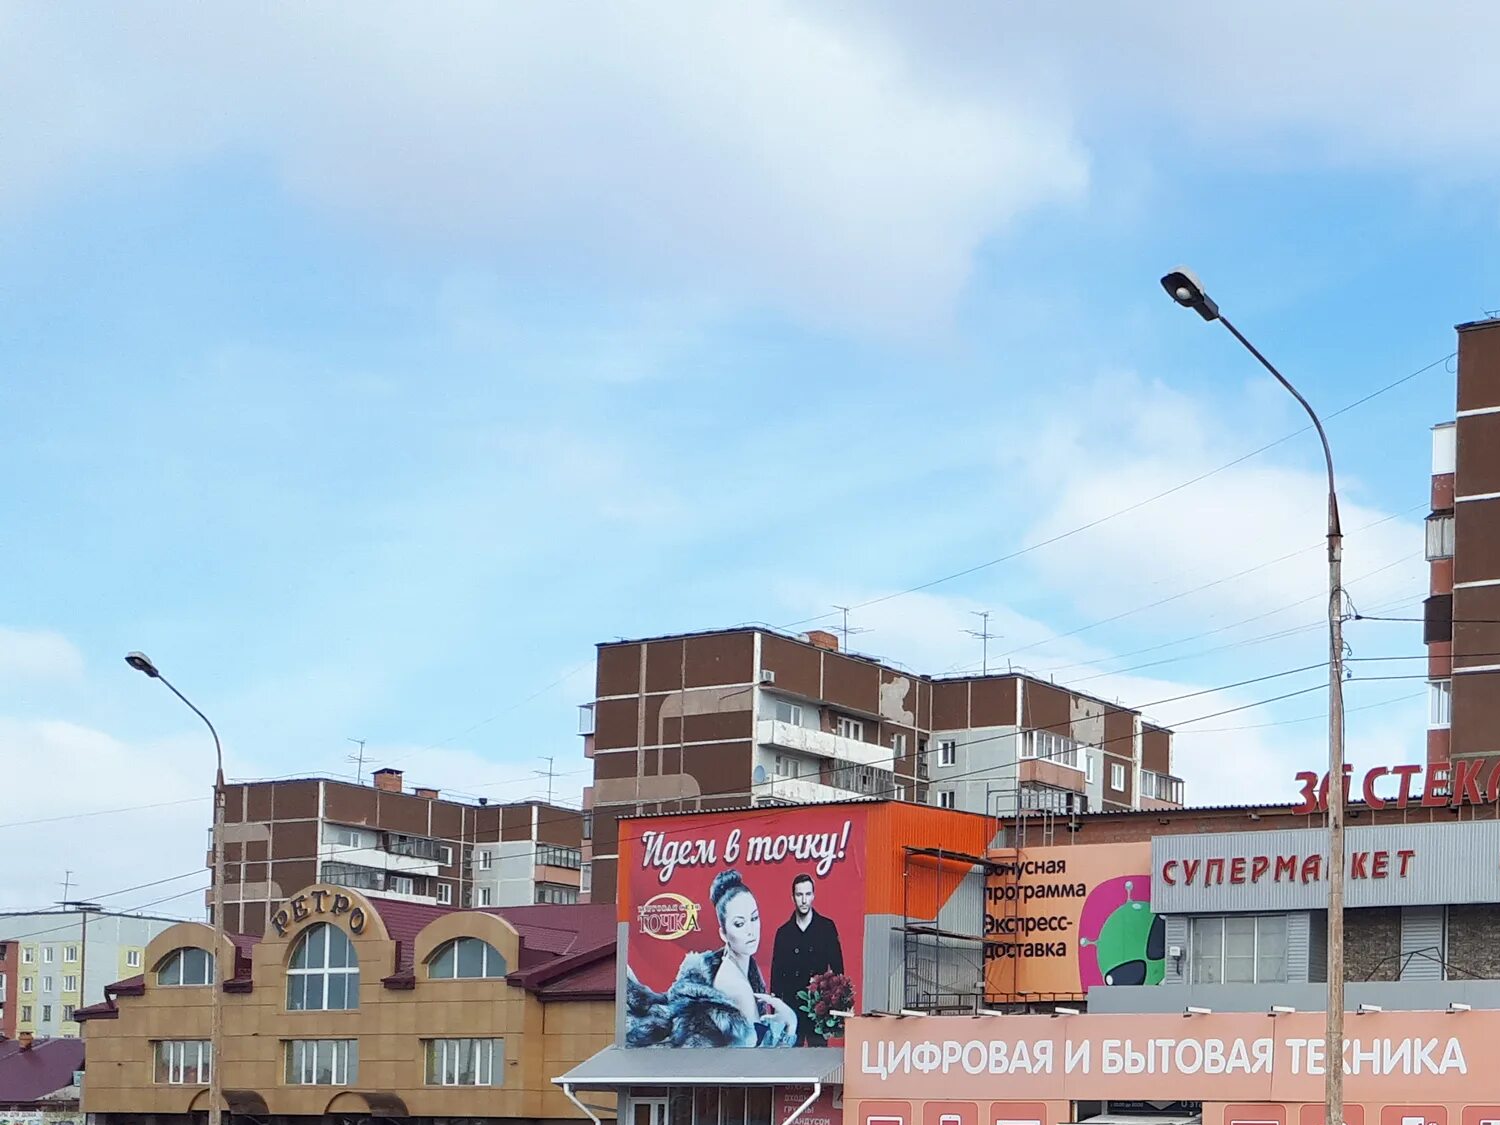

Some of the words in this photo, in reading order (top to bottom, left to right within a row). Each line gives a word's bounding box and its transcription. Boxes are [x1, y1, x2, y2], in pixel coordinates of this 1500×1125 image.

[641, 831, 717, 882] Идем
[723, 829, 742, 868] в
[747, 821, 852, 876] точку!
[1162, 850, 1416, 888] СУПЕРМАКЕТ
[271, 889, 367, 938] РЕТРО
[861, 1040, 1053, 1080] ЦИФРОВАЯ
[1064, 1040, 1090, 1073] И
[1102, 1038, 1273, 1074] БЫТОВАЯ
